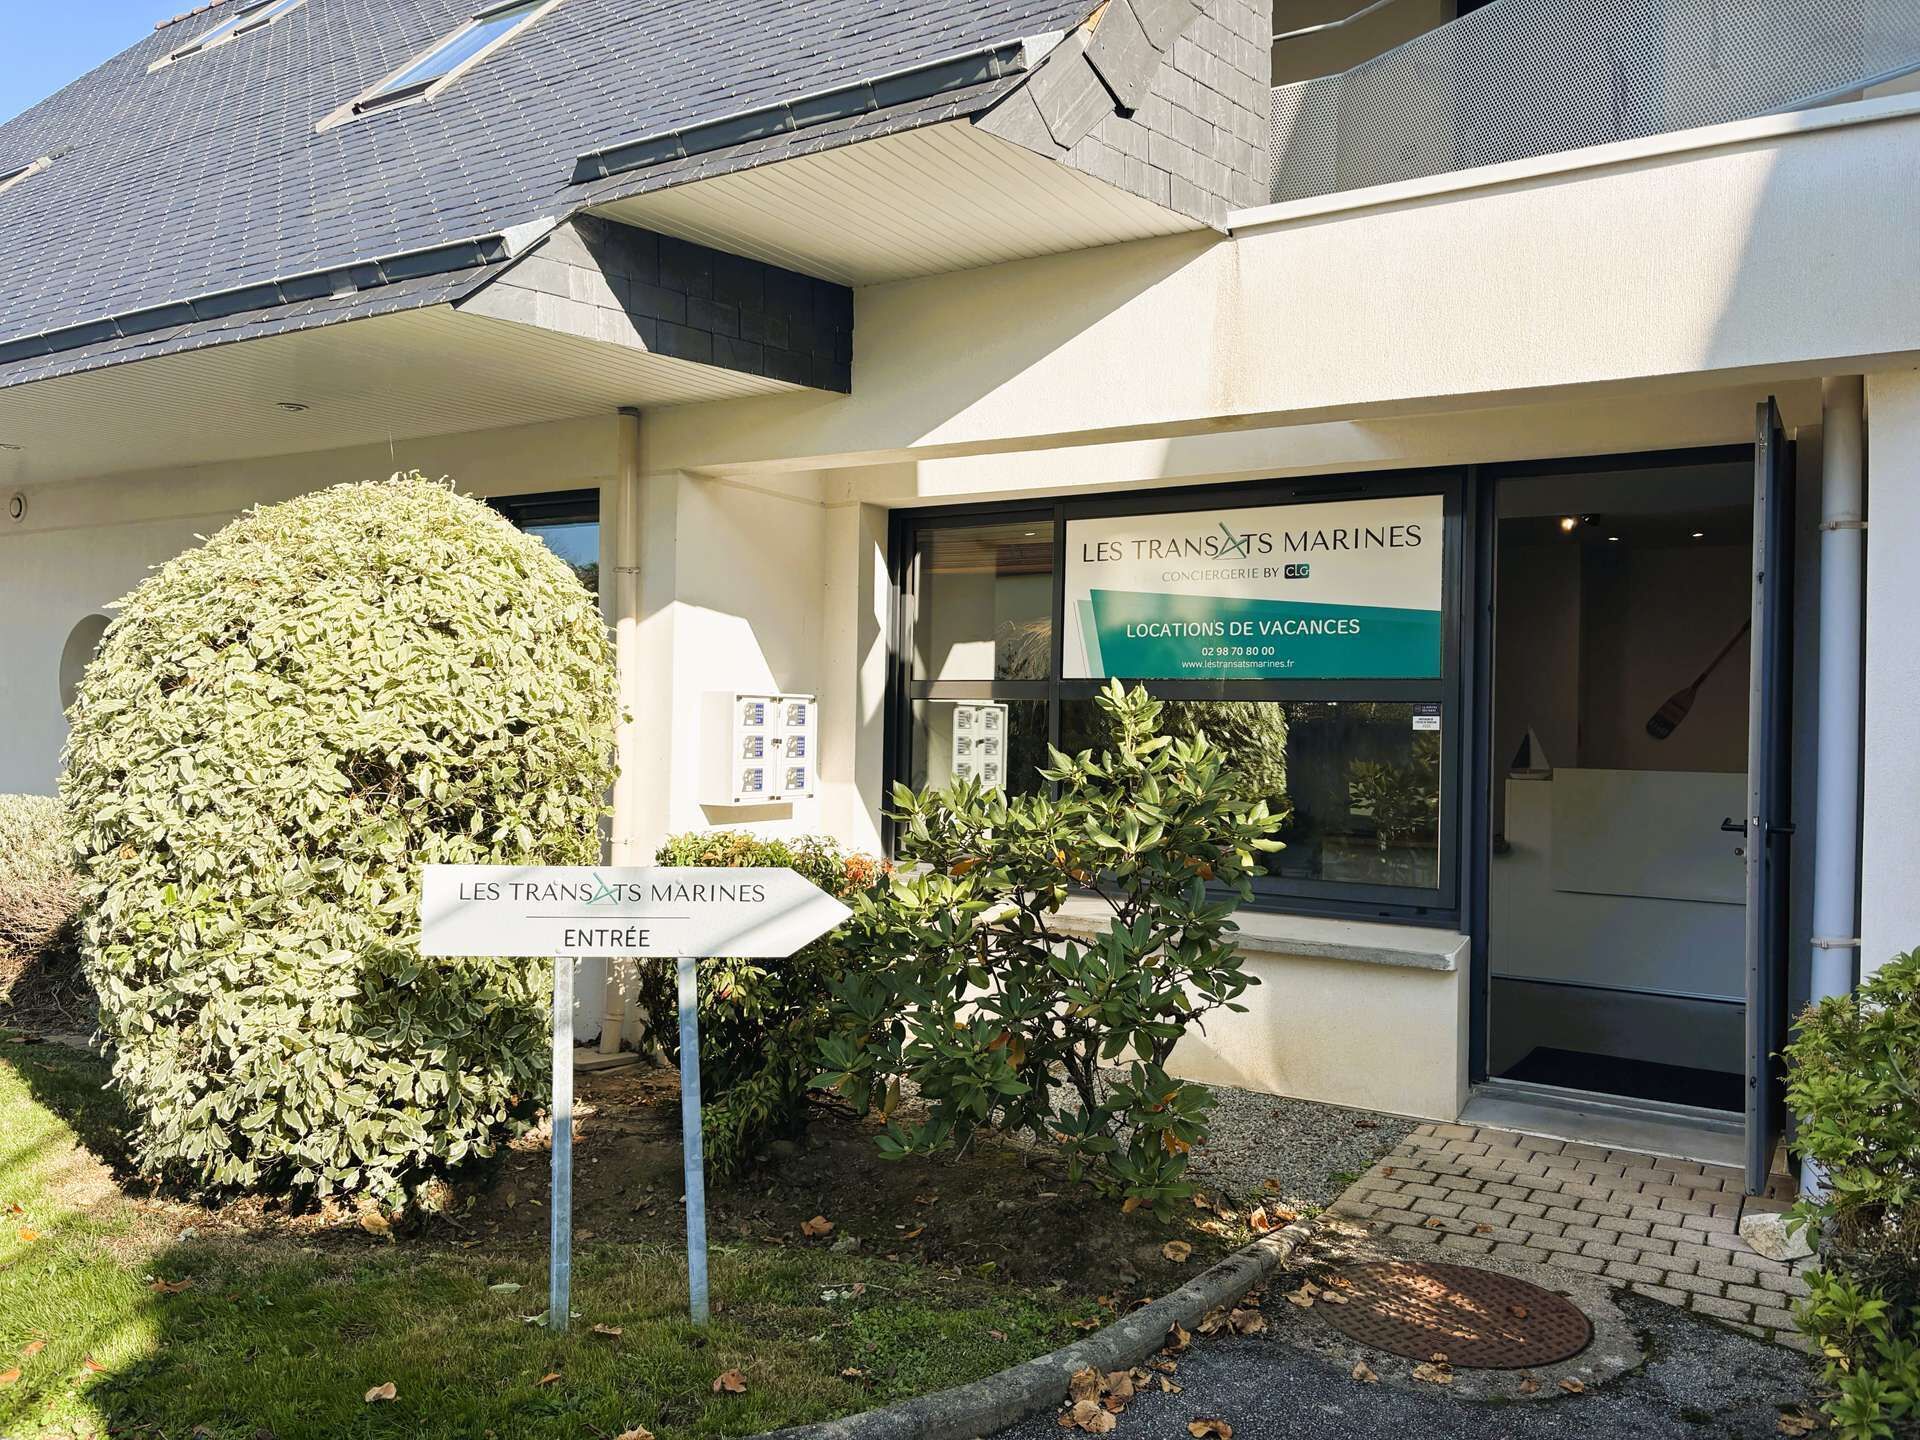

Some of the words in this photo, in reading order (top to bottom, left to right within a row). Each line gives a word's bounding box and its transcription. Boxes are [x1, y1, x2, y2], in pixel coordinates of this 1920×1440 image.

[1083, 542, 1122, 562] LES
[1132, 521, 1272, 560] TRANSATS
[1283, 525, 1421, 552] MARINES
[1161, 567, 1259, 583] CONCIERGERIE
[1263, 567, 1279, 578] BY
[1126, 621, 1225, 638] LOCATIONS
[1229, 621, 1253, 636] DE
[1258, 619, 1361, 635] VACANCES
[1201, 647, 1214, 656] 02
[1216, 647, 1229, 656] 98
[1231, 647, 1243, 656] 70
[1246, 647, 1258, 656] 80
[1261, 646, 1275, 656] 00
[1182, 658, 1295, 669] www.lestransatsmarines.fr
[459, 882, 500, 901] LES
[508, 872, 642, 905] TRANSATS
[651, 884, 765, 903] MARINES
[564, 925, 650, 947] ENTRÉE
